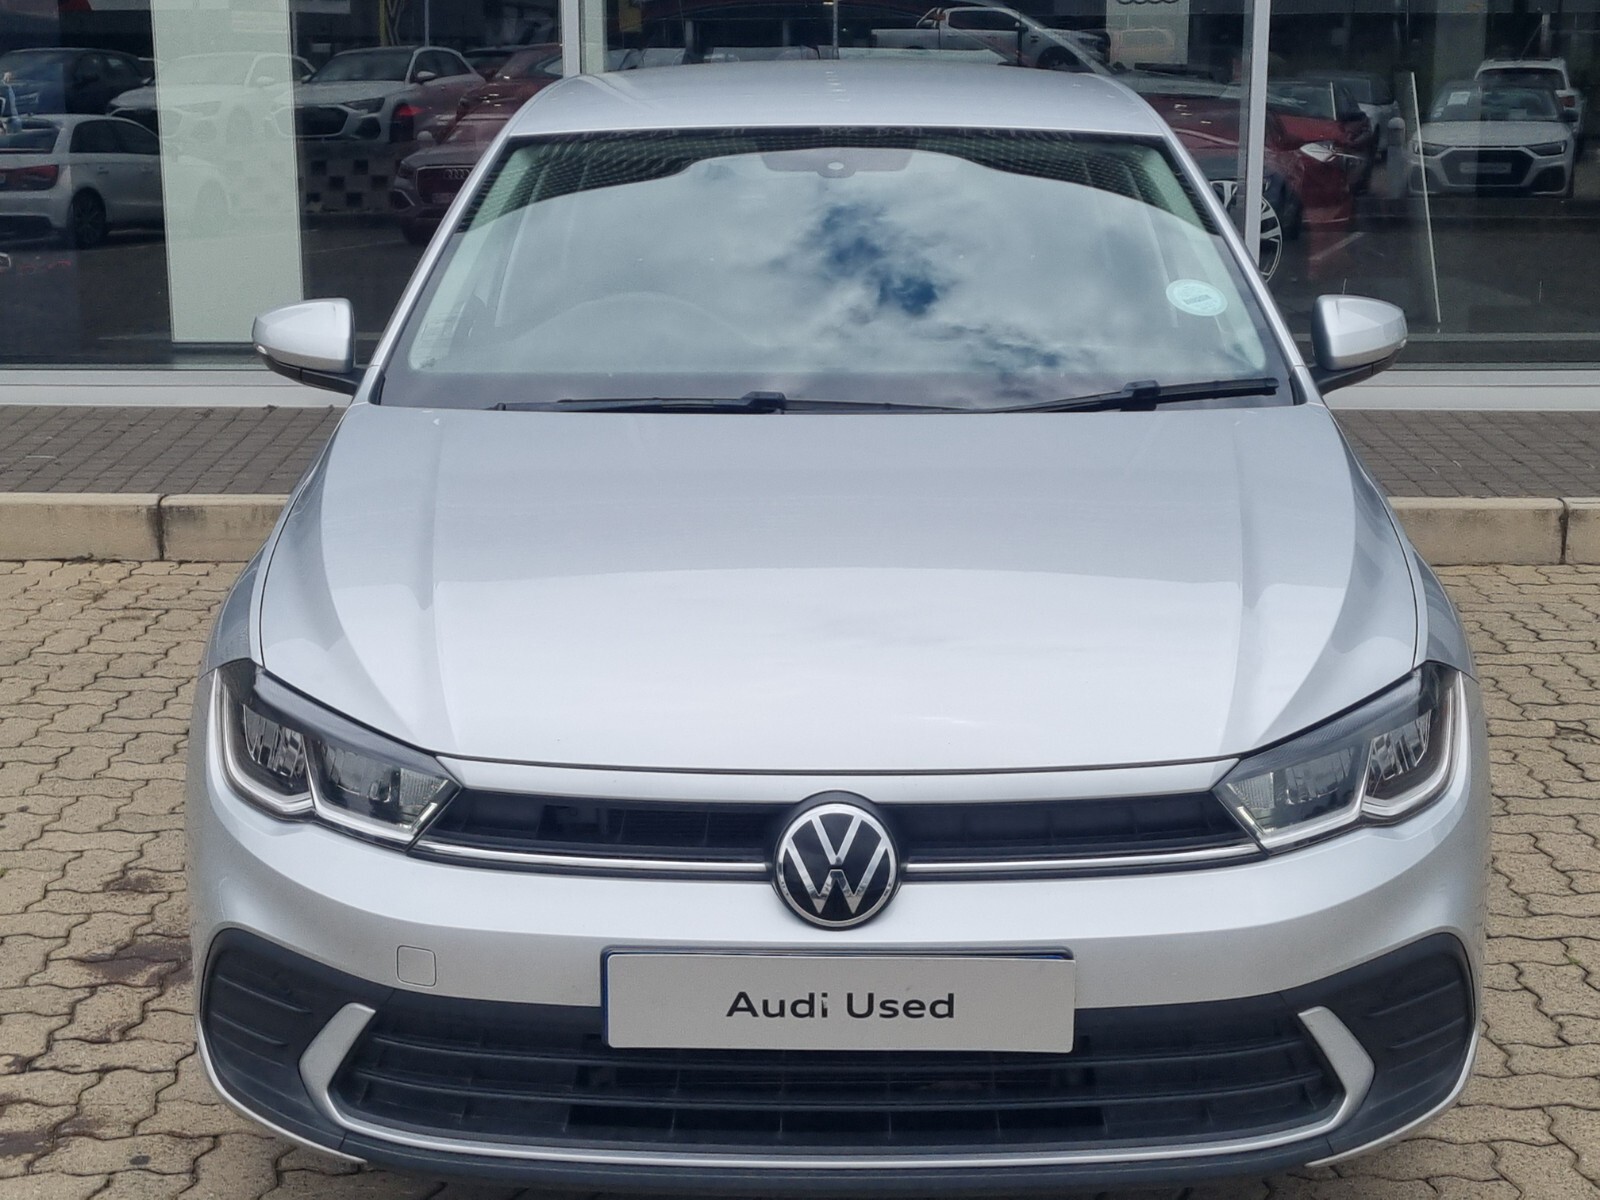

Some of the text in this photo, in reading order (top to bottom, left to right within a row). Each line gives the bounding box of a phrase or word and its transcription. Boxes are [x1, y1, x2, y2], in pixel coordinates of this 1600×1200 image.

[776, 803, 897, 927] VW
[726, 991, 955, 1019] Audi Used
